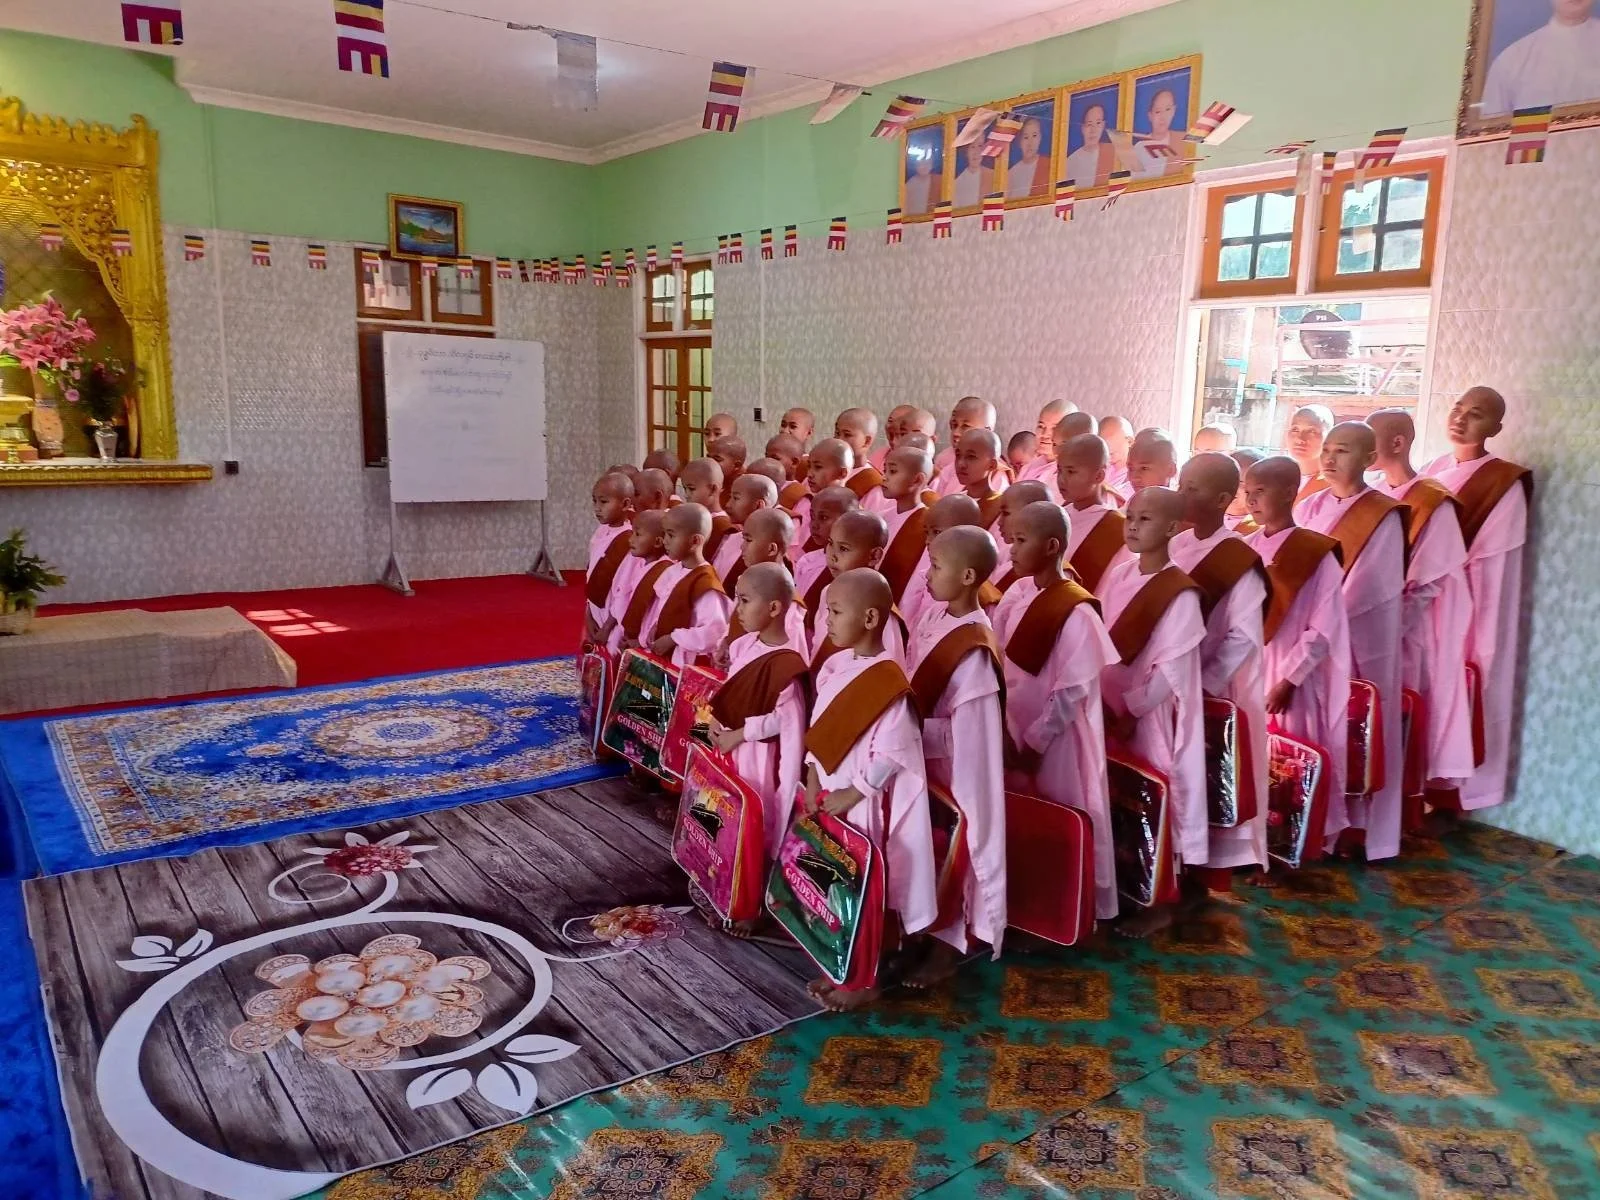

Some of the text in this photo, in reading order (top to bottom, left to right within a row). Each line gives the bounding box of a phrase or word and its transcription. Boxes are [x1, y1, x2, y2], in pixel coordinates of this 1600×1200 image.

[617, 714, 664, 746] GOLDEN SHI
[683, 817, 723, 867] GOLDEN SHIP
[785, 867, 818, 905] GOLDEN
[815, 901, 835, 927] SHIP
